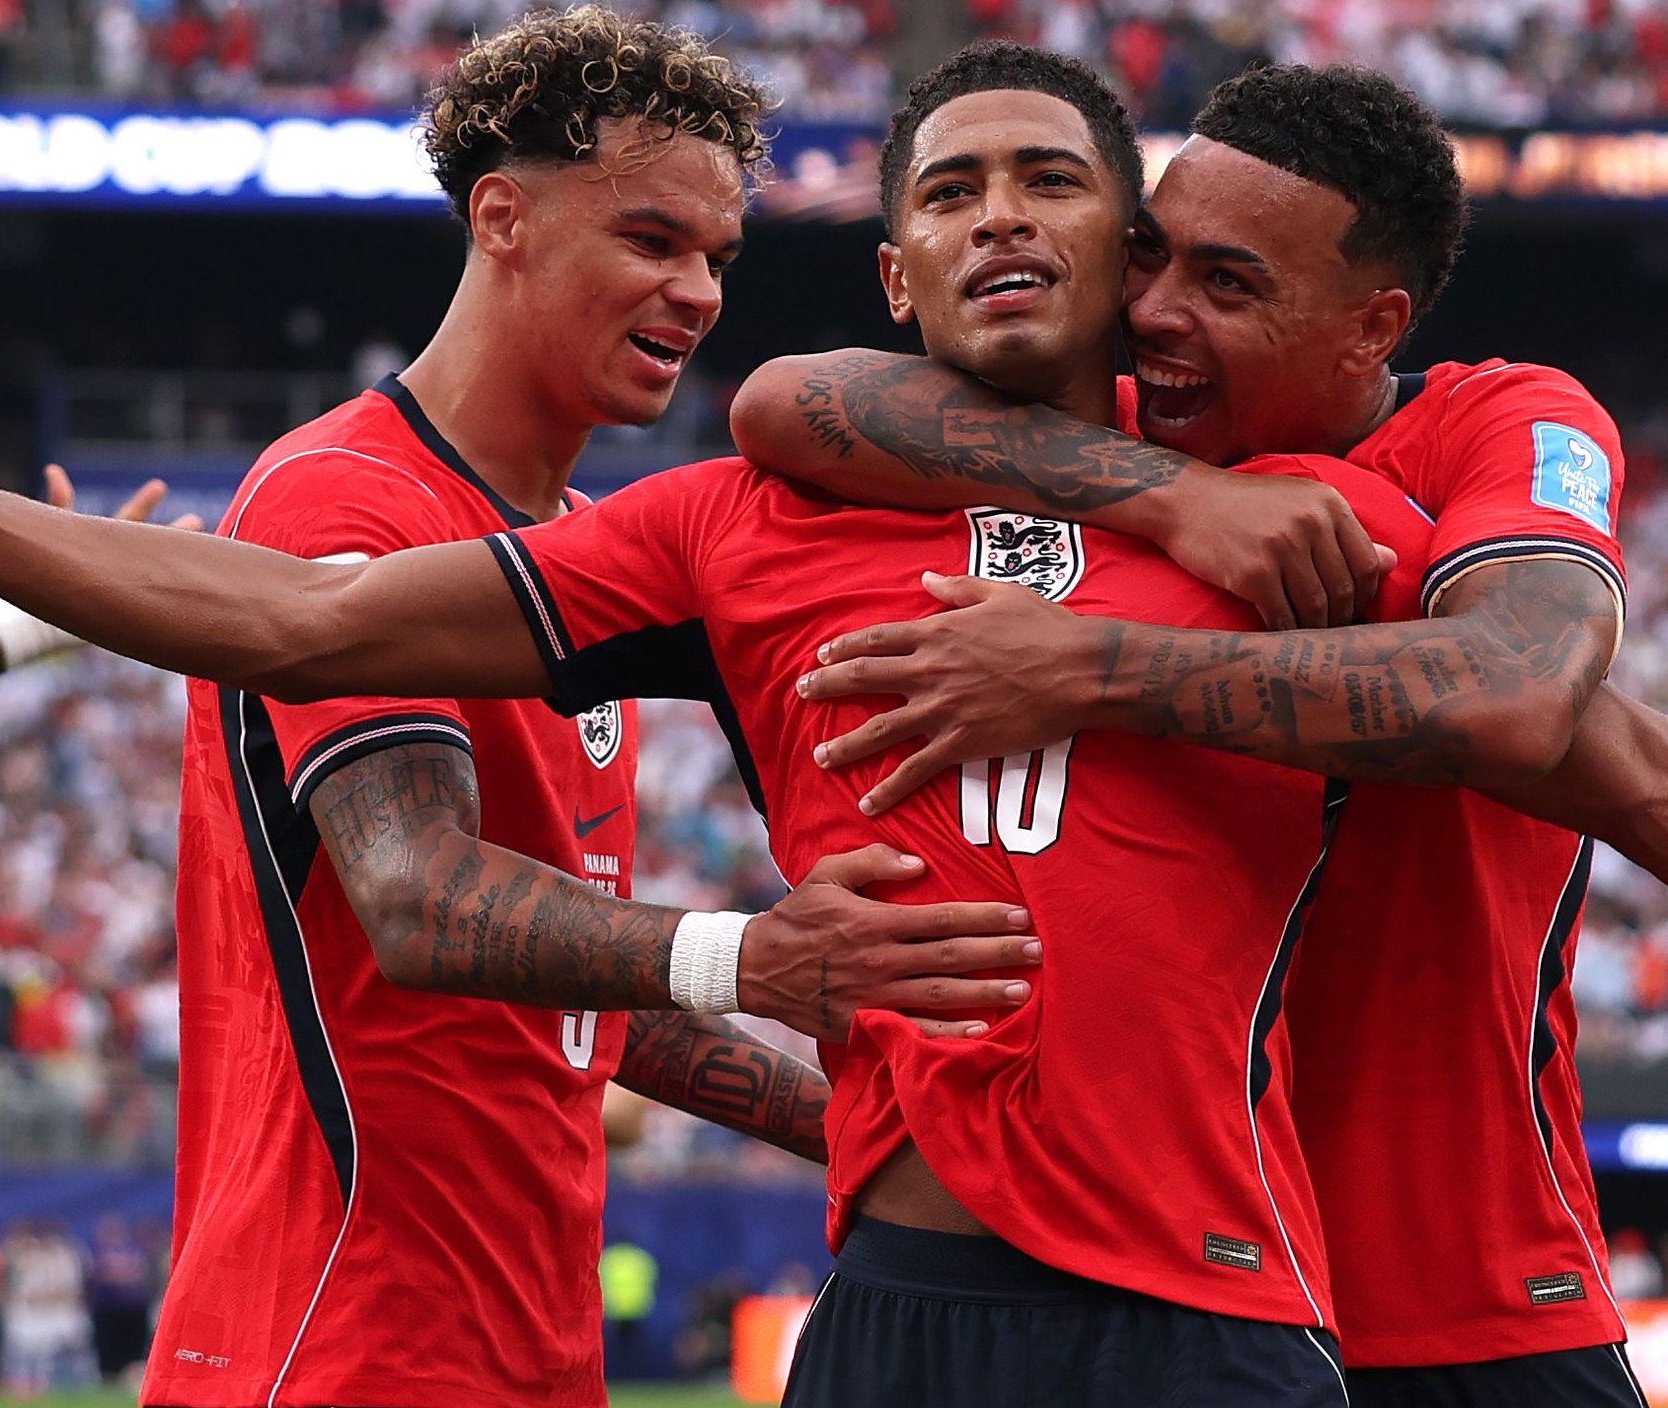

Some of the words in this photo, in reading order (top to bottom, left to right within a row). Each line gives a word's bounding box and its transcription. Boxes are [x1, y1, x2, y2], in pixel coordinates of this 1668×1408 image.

[109, 114, 266, 196] CUP
[1562, 476, 1598, 511] PEACE
[583, 852, 620, 876] PANAMA
